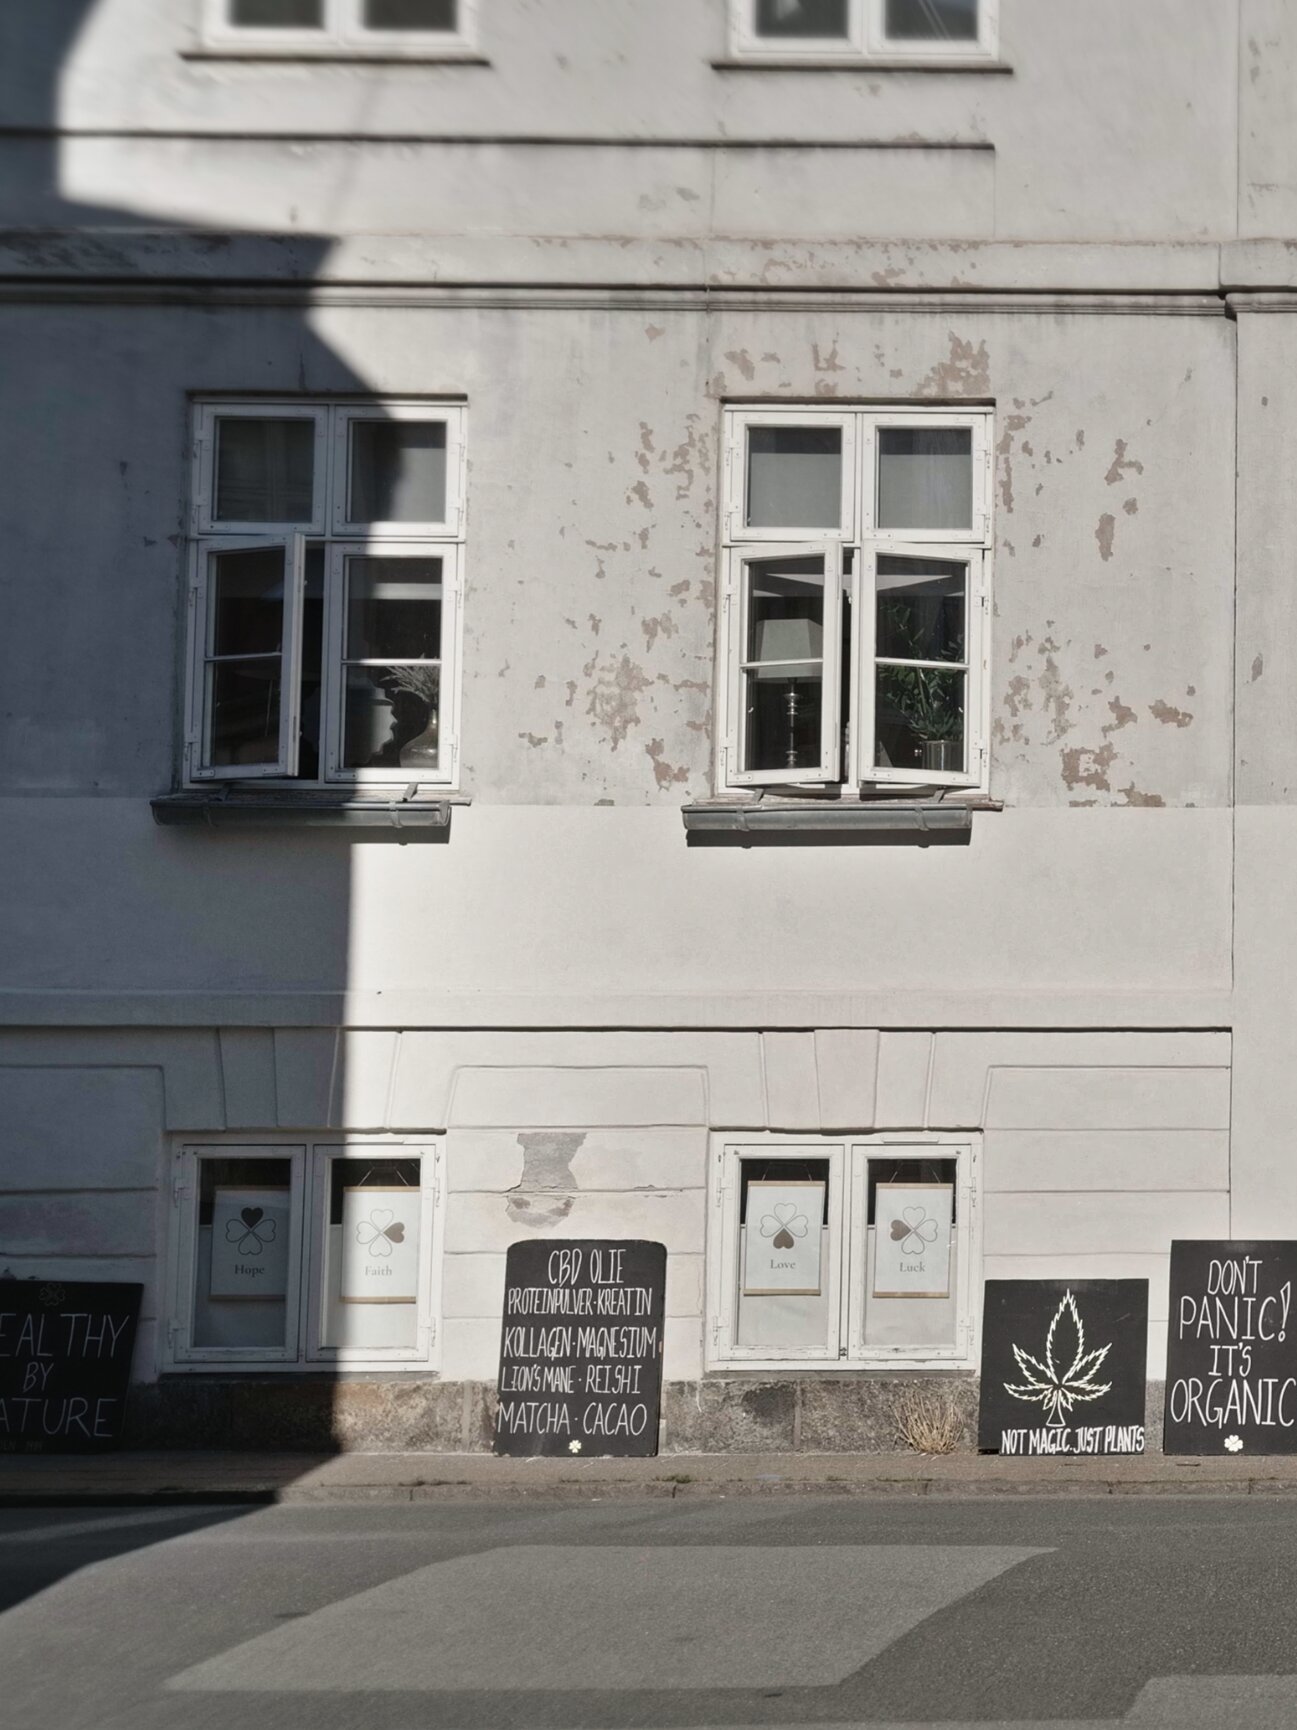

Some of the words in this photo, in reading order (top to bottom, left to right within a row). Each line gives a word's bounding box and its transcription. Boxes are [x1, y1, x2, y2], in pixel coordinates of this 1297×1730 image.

[234, 1264, 265, 1278] Hope
[365, 1264, 392, 1277] Faith
[548, 1248, 583, 1287] CBD
[590, 1248, 627, 1284] OLIE
[770, 1258, 797, 1270] Love
[899, 1261, 926, 1273] Luck
[1207, 1255, 1263, 1295] DON'T
[1179, 1281, 1291, 1342] PANIC!
[1208, 1342, 1252, 1377] IT'S
[22, 1361, 55, 1393] BY
[501, 1364, 541, 1392] LION'S
[543, 1365, 577, 1393] MANE
[585, 1364, 643, 1394] REISHI
[498, 1401, 571, 1435] MATCHA
[582, 1401, 648, 1436] CACAO
[1170, 1378, 1297, 1429] ORGANIC
[1001, 1428, 1028, 1454] NOT
[1073, 1426, 1103, 1452] JUST
[1104, 1425, 1145, 1452] PLANTS
